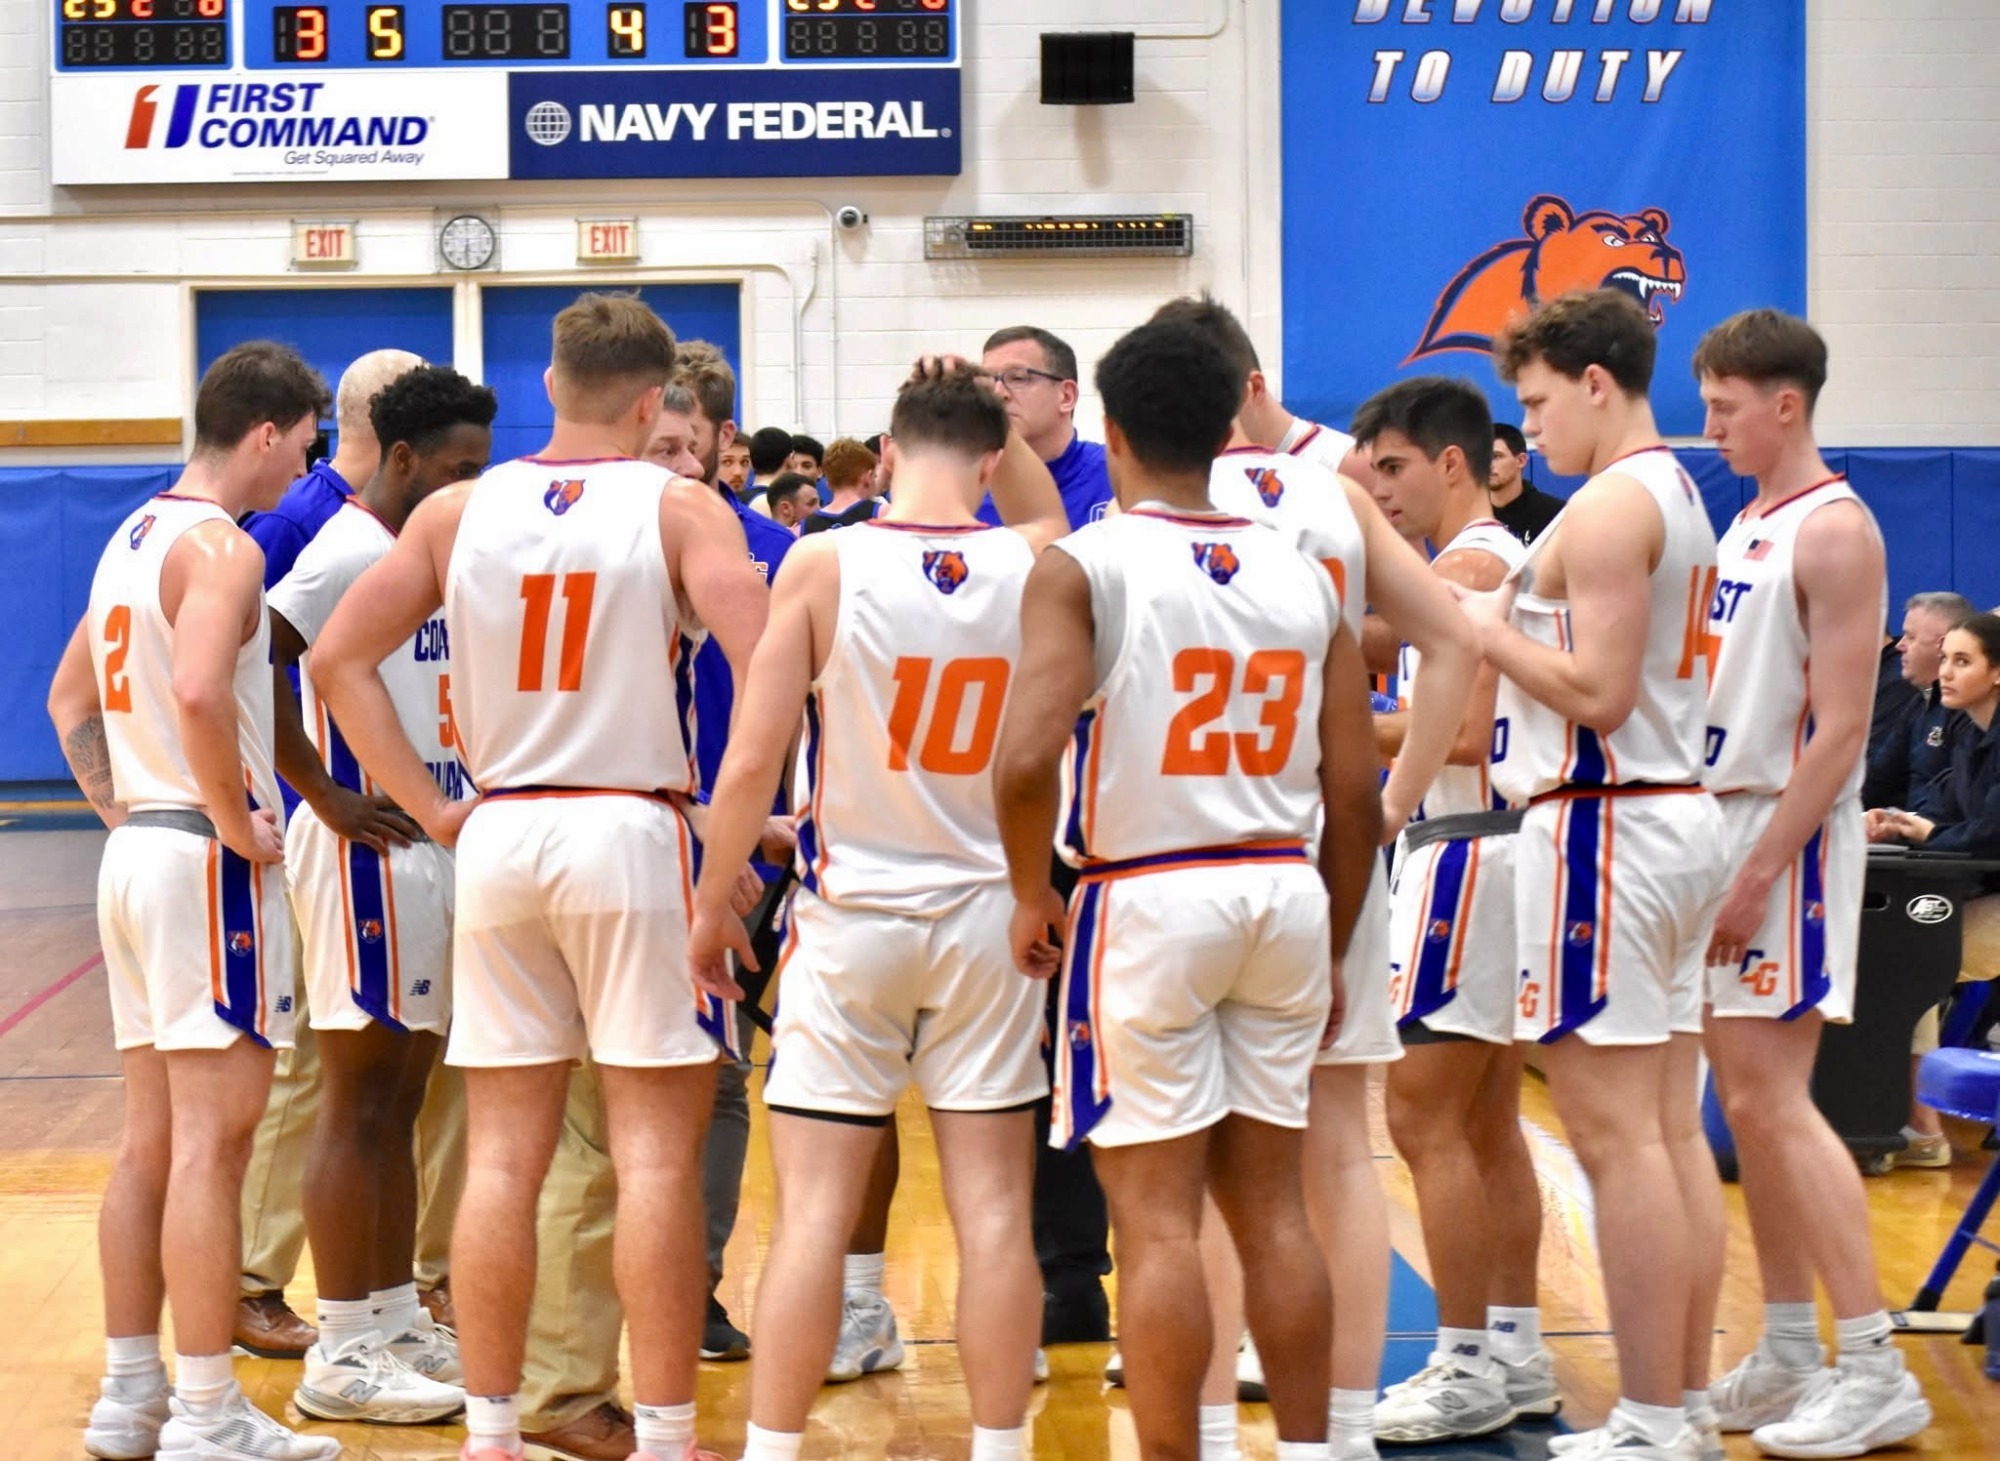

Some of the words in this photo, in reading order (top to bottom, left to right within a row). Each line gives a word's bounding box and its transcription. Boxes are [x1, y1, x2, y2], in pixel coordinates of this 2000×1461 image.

[297, 9, 325, 59] 3
[369, 8, 402, 58] 5
[610, 9, 643, 51] 4
[706, 4, 736, 55] 3
[206, 82, 324, 113] FIRST
[1366, 49, 1452, 103] TO
[1490, 49, 1684, 103] DUTY
[200, 116, 429, 149] COMMAND
[580, 102, 717, 142] NAVY
[727, 100, 938, 140] FEDERAL
[284, 150, 311, 165] Get
[314, 149, 378, 167] Squared
[380, 149, 424, 166] Away
[304, 228, 346, 258] EXIT
[589, 224, 629, 254] EXIT
[517, 571, 597, 692] 11
[104, 604, 132, 714] 2
[888, 656, 1010, 775] 10
[1161, 647, 1306, 777] 23
